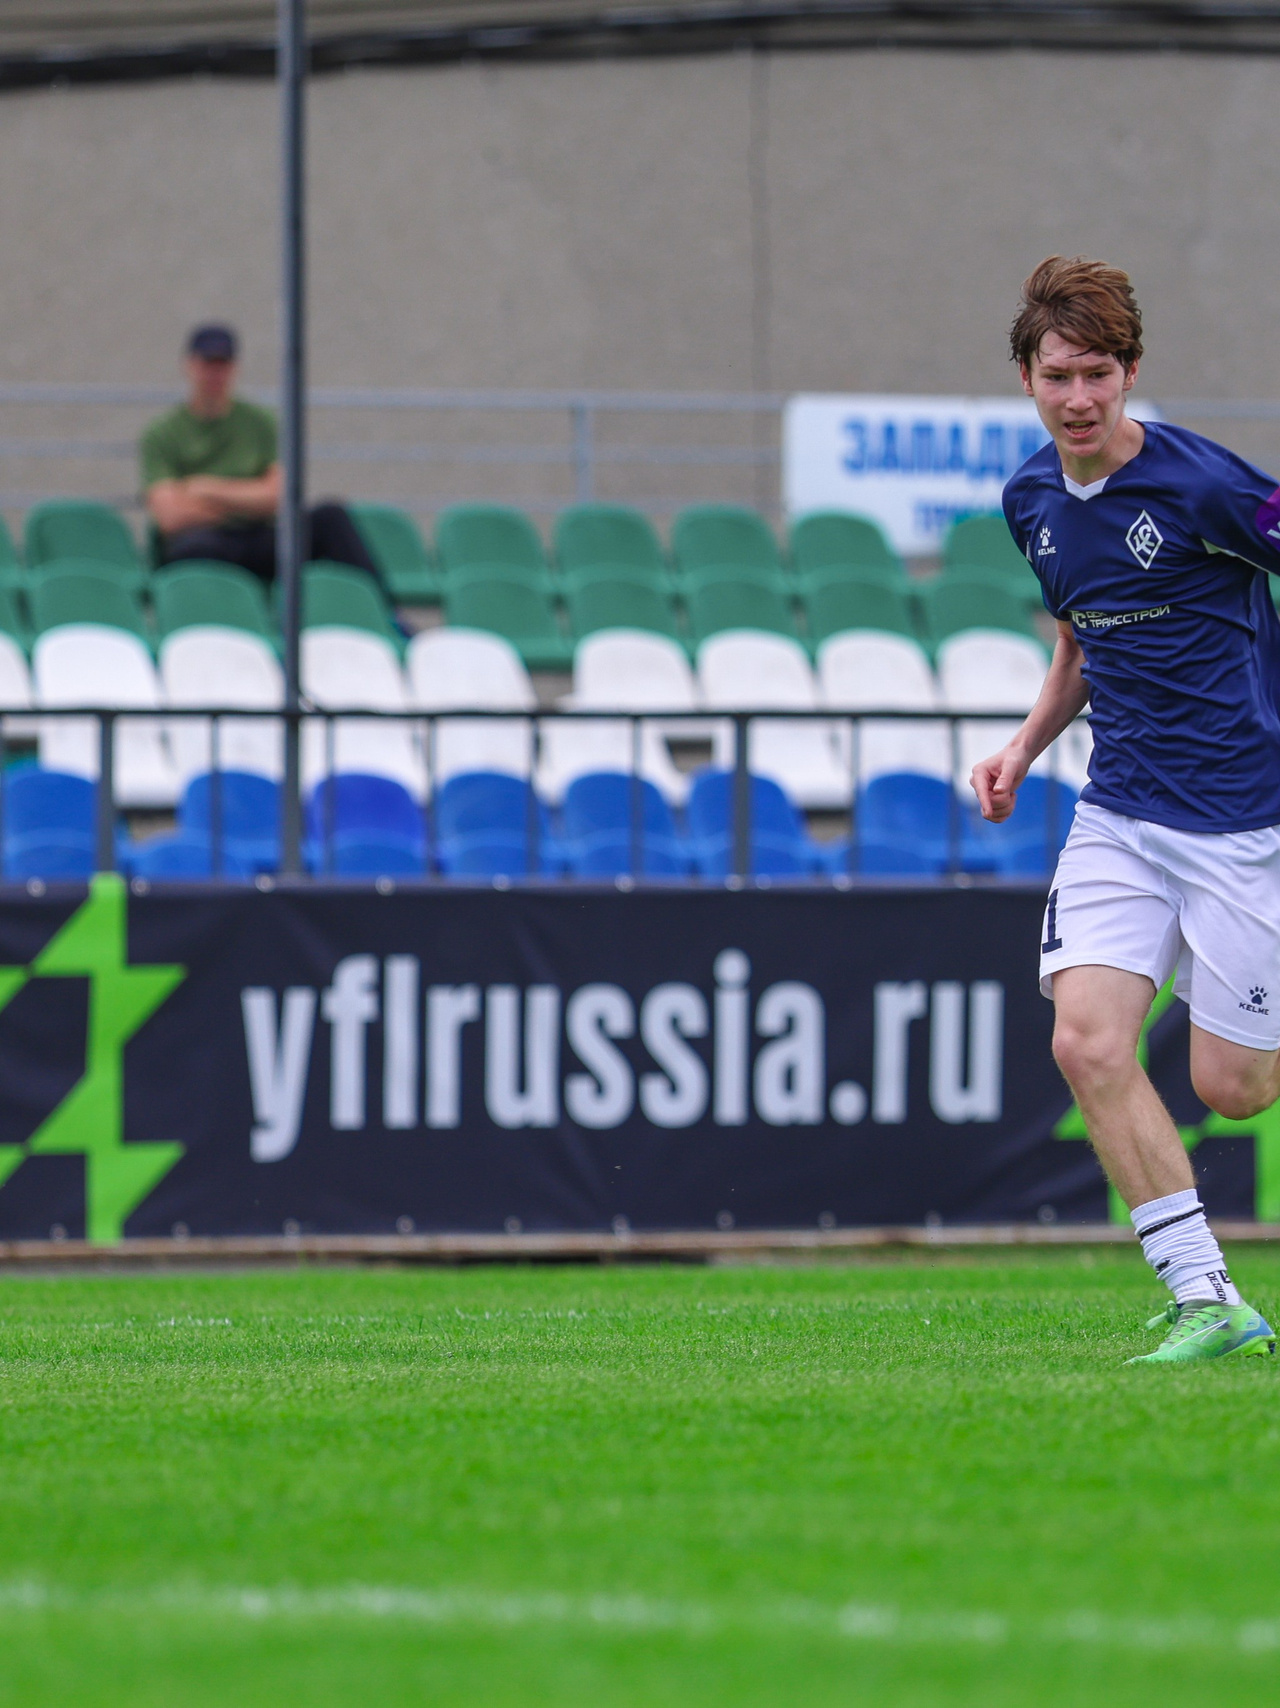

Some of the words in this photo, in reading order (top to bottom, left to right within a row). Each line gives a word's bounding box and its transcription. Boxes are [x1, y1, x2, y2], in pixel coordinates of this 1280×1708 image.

[843, 416, 1046, 483] ЗАПАДН
[1037, 546, 1056, 556] KELME
[1238, 1002, 1270, 1016] KELME
[240, 948, 1004, 1164] yflrussia.ru
